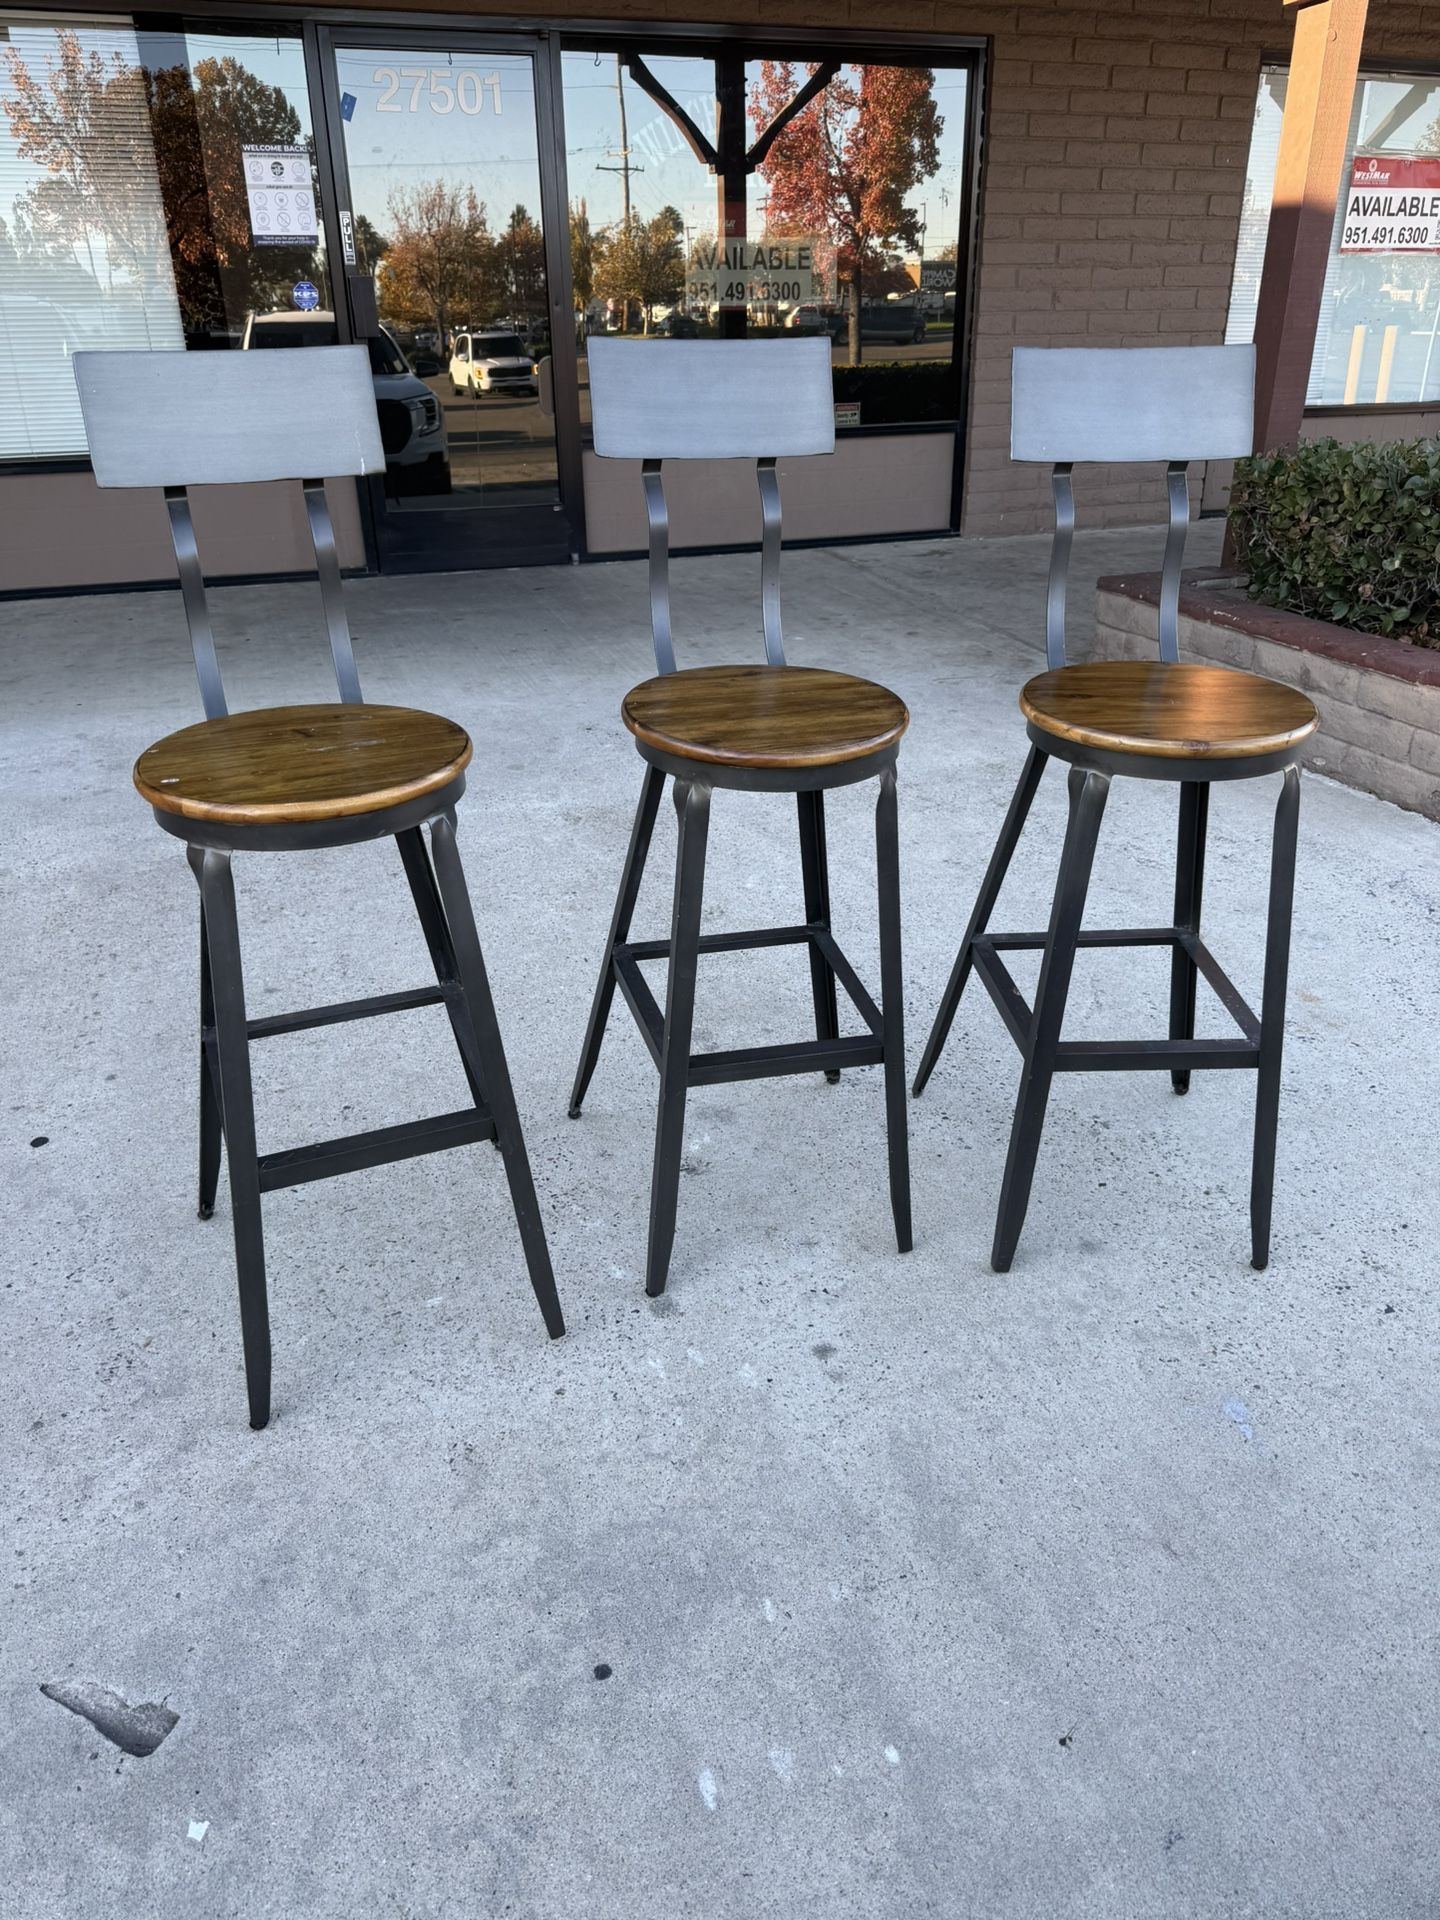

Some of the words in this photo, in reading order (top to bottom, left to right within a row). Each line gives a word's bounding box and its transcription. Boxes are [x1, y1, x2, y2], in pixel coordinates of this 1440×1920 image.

[373, 67, 503, 116] 27501
[242, 144, 282, 152] WELCOME
[1348, 195, 1440, 217] AVAILABLE
[343, 217, 353, 252] PULL
[1345, 226, 1429, 244] 951.491.6300
[688, 245, 811, 271] AVAILABLE
[688, 281, 801, 301] 951.491.6300
